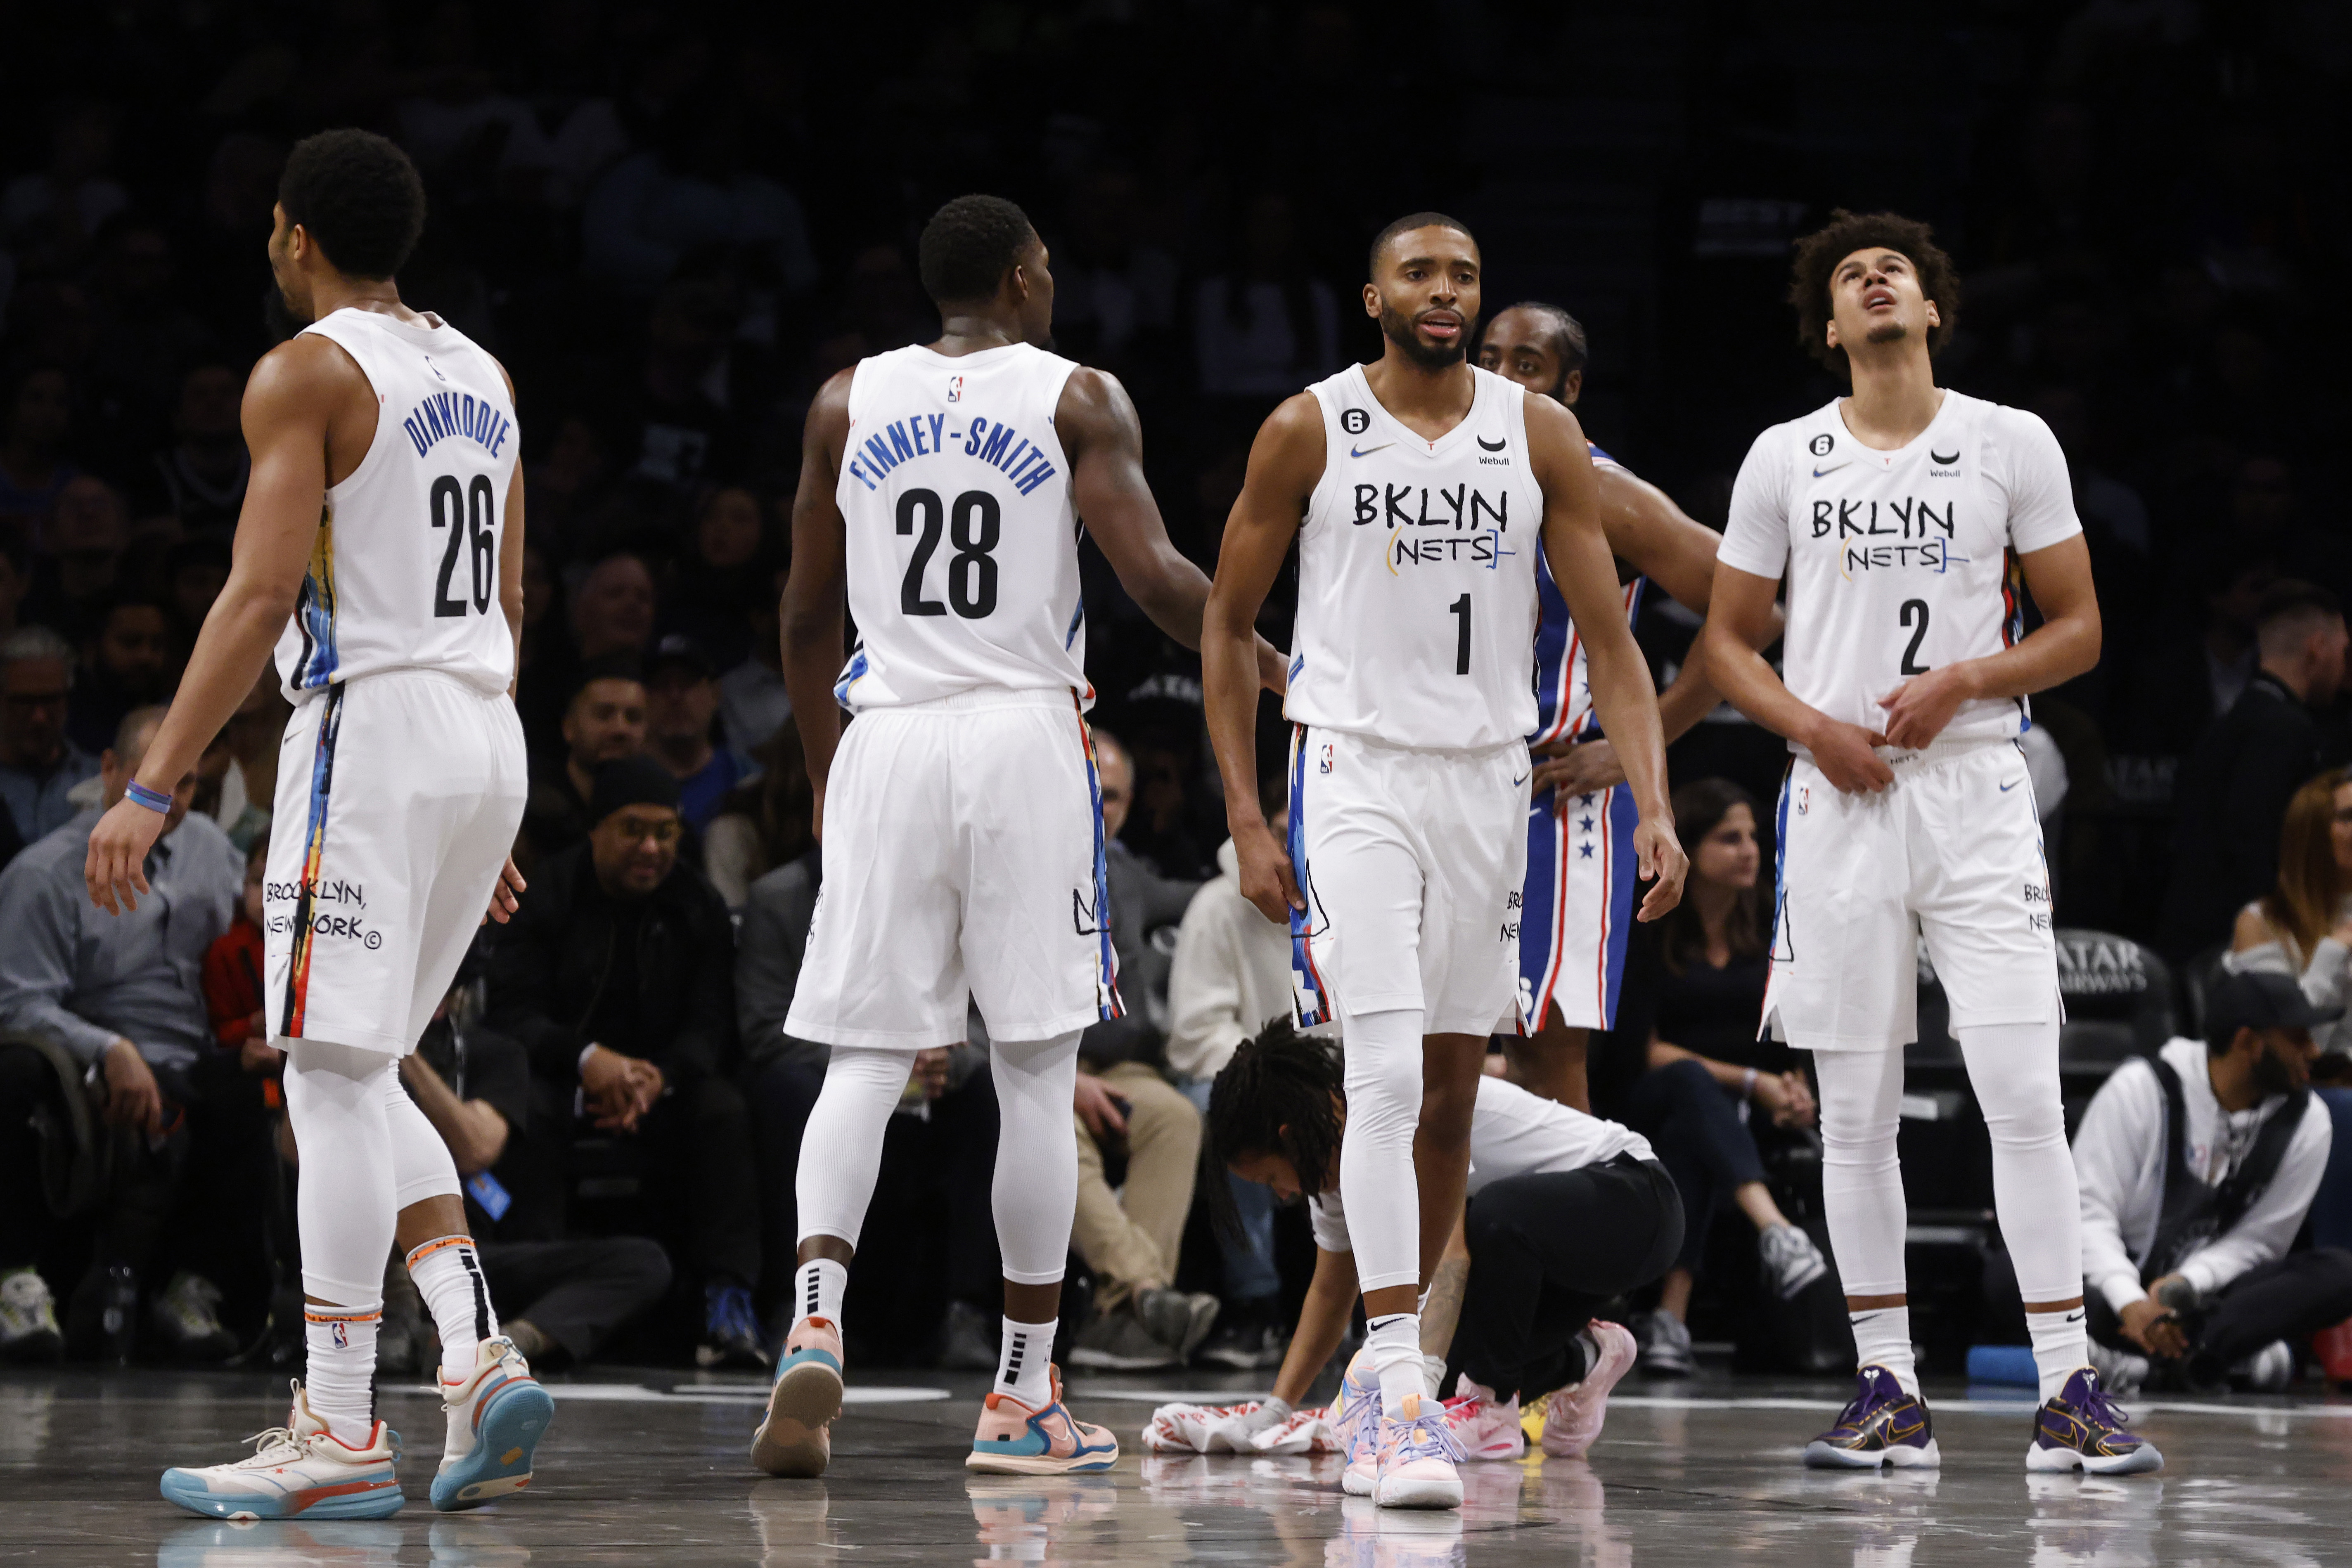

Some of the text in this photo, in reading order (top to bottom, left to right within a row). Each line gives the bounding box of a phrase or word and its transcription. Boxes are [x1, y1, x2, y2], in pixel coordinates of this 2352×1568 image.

[1348, 412, 1363, 432] 6
[849, 413, 1056, 496] FINNEY-SMITH
[1479, 456, 1509, 466] Webull
[1930, 469, 1961, 478] Webull
[1353, 482, 1507, 532] BKLYN
[1811, 496, 1954, 539] BKLYN
[430, 474, 494, 617] 26
[896, 488, 1000, 619] 28
[1450, 593, 1471, 674] 1
[1900, 598, 1930, 676] 2
[2056, 939, 2145, 971] ATAR
